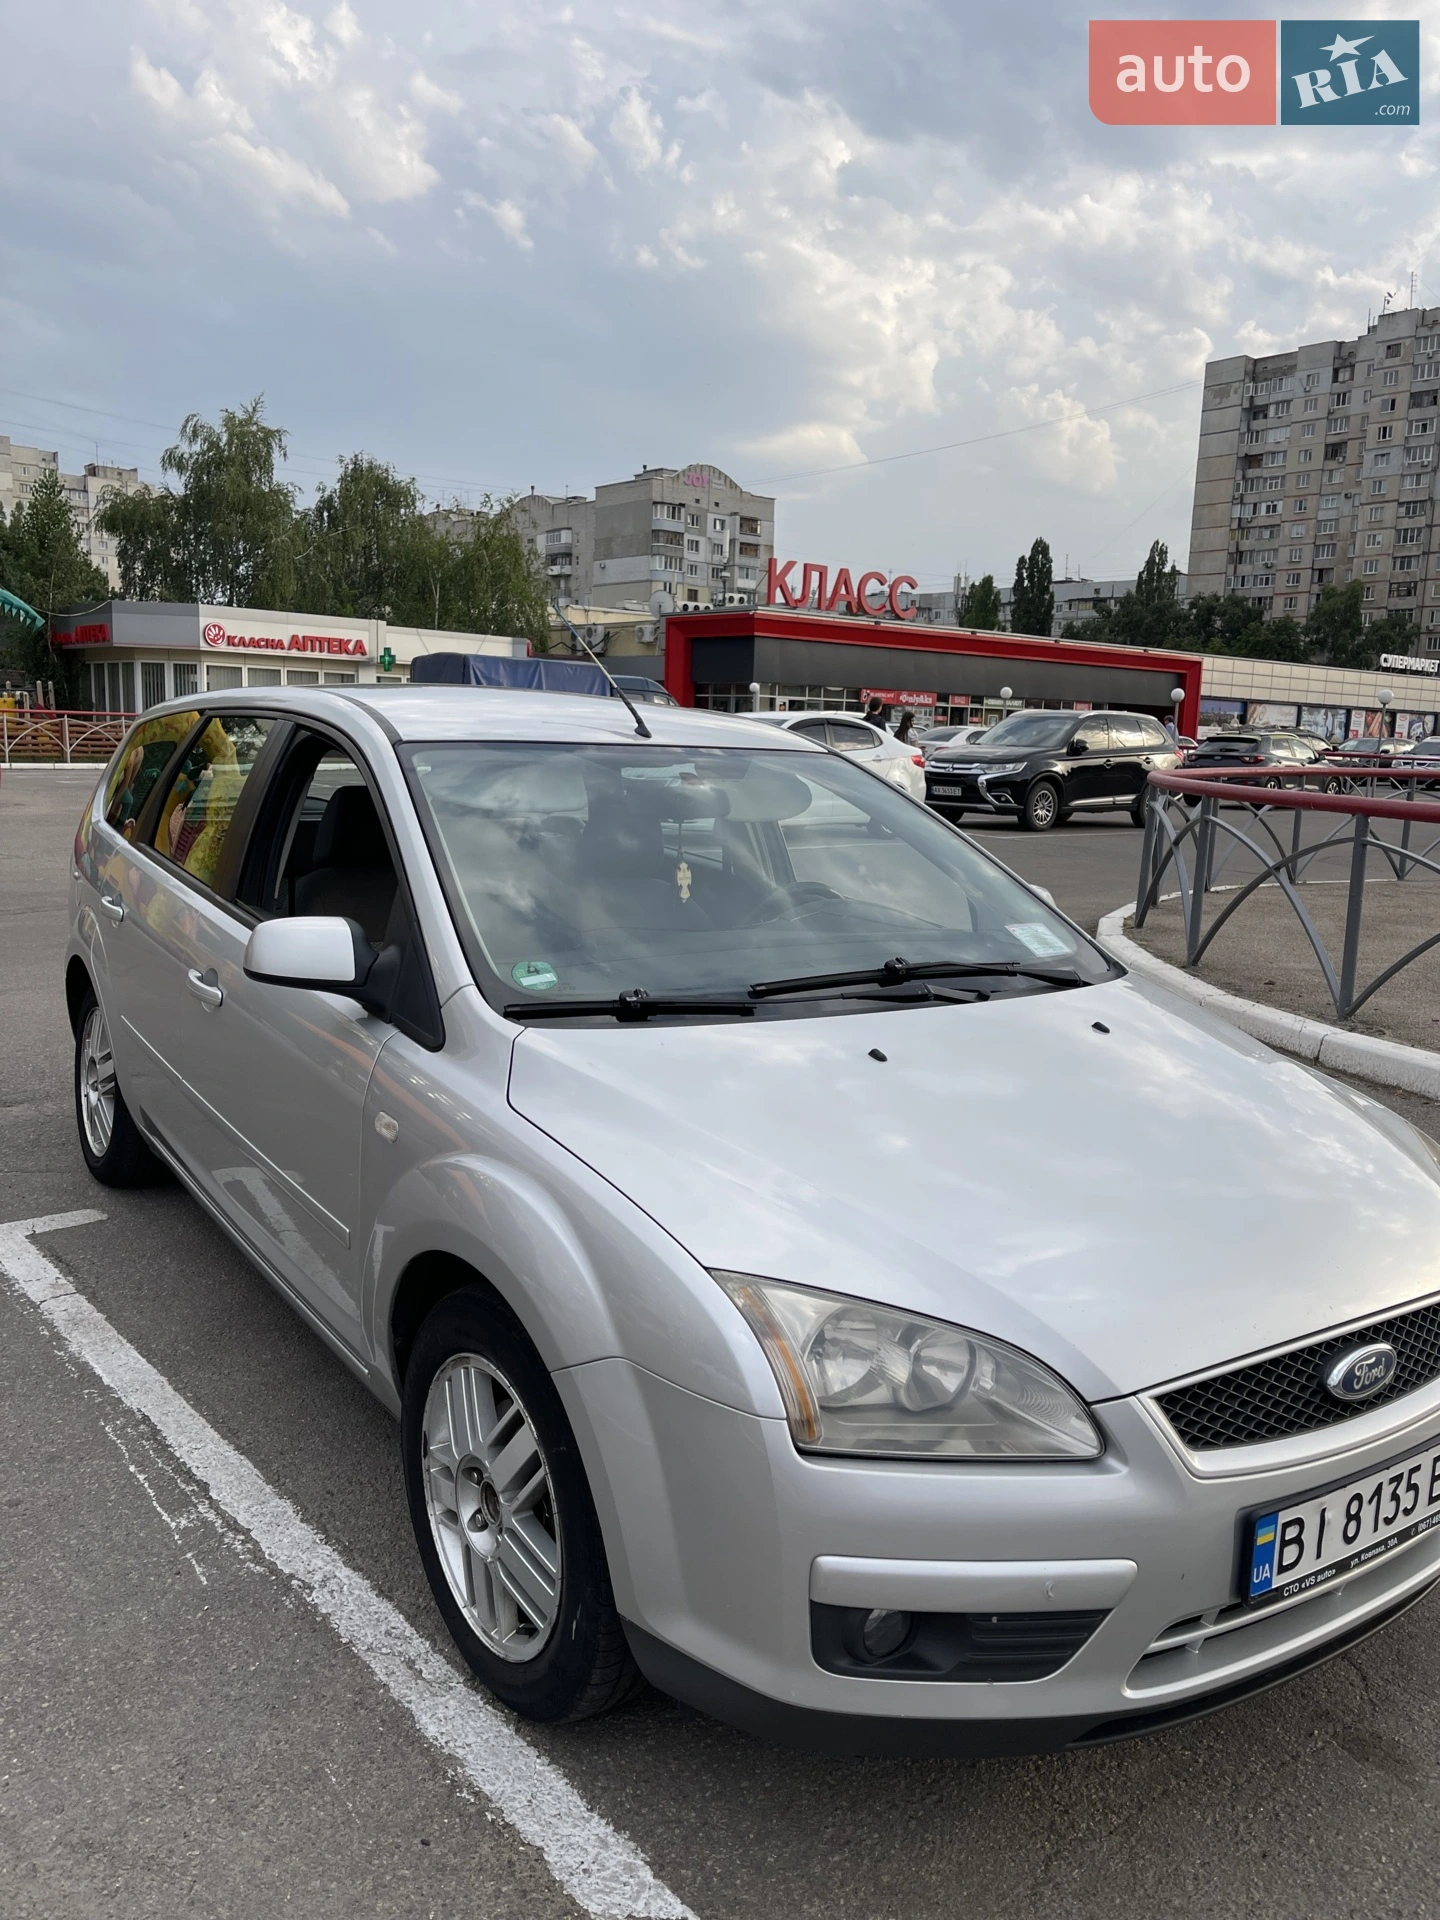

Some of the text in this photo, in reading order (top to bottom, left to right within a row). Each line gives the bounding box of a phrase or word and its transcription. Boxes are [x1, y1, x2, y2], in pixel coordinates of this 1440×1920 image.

[766, 557, 919, 619] КЛАСС
[227, 634, 368, 656] КЛАСНА АПТЕКА
[1380, 653, 1440, 672] СУПЕРМАРКЕТ
[1353, 1356, 1386, 1390] Ford
[1342, 1464, 1422, 1545] 8135
[1253, 1563, 1271, 1584] UA
